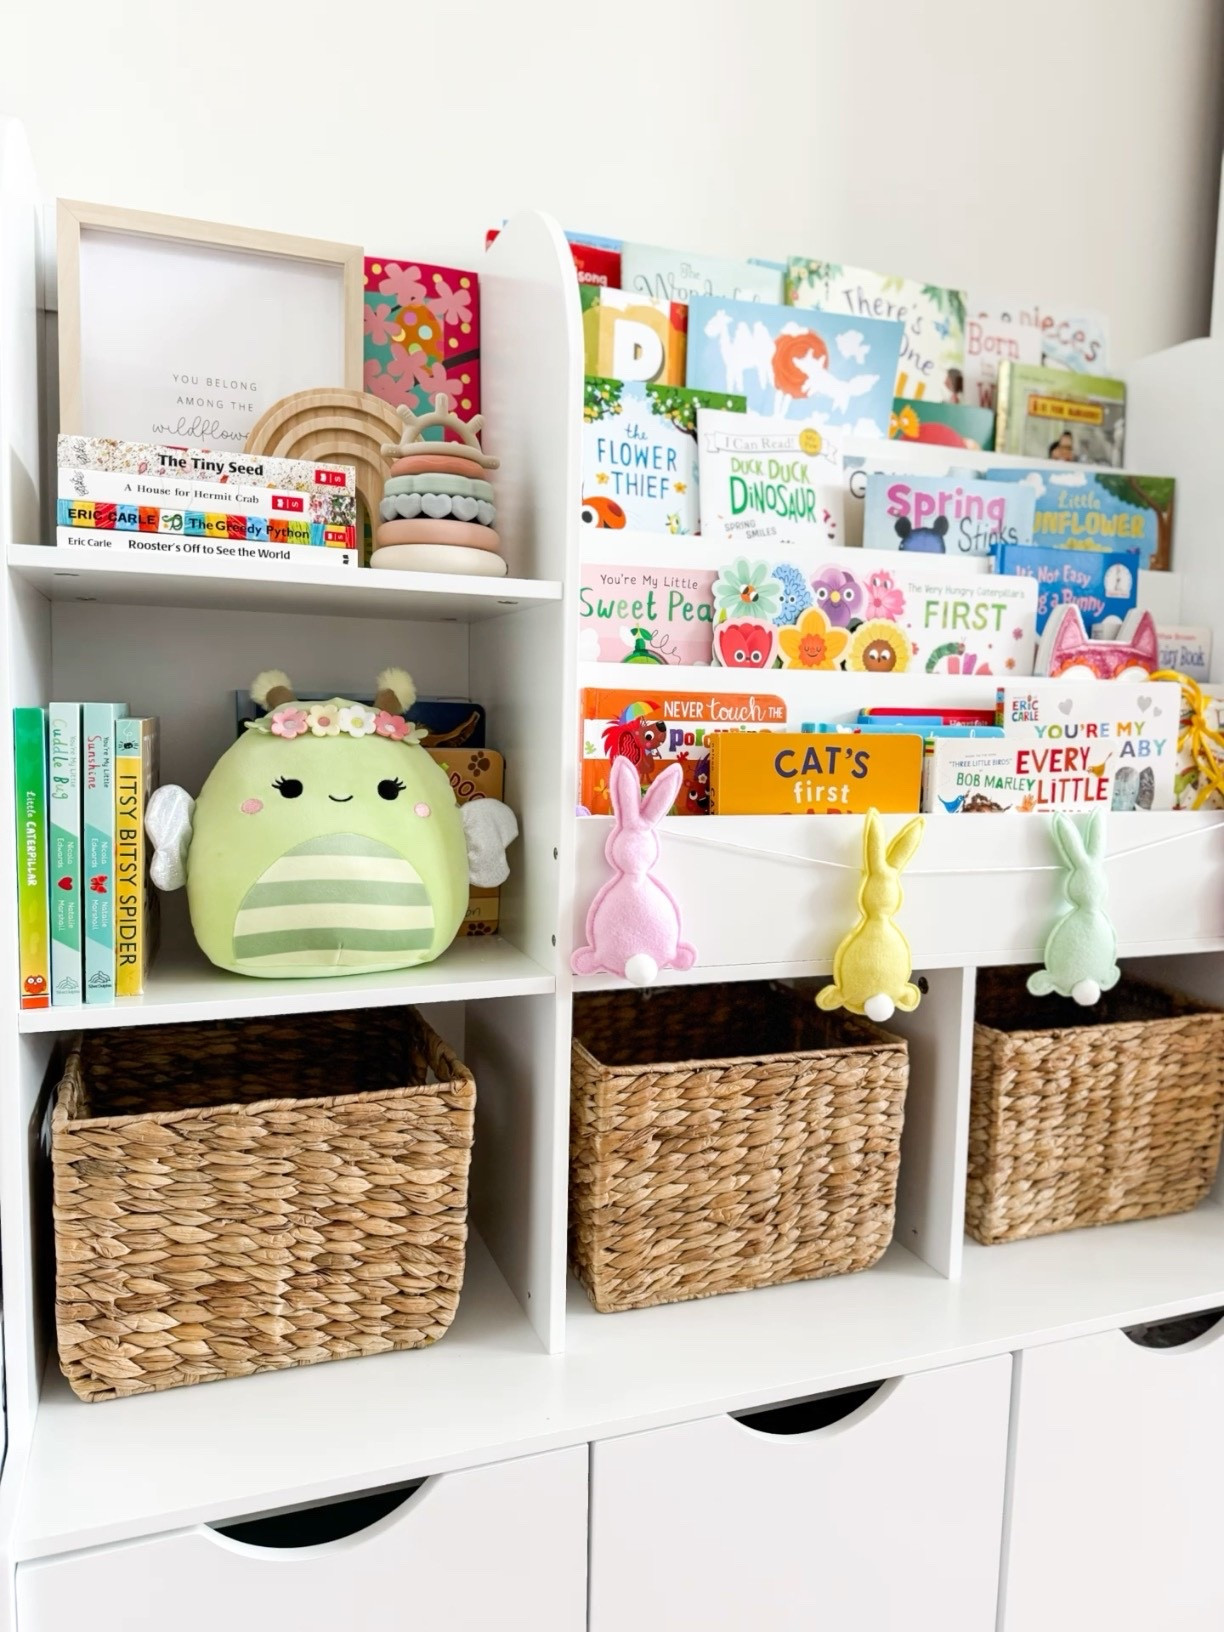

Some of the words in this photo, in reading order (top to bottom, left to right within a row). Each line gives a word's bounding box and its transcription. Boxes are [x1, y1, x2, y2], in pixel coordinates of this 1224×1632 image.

[968, 321, 1019, 360] Born
[172, 374, 199, 385] YOU
[206, 377, 258, 392] BELONG
[176, 396, 224, 409] AMONG
[231, 401, 254, 412] THE
[624, 423, 648, 441] the
[597, 437, 677, 472] FLOWER
[733, 438, 758, 450] Can
[158, 453, 187, 469] The
[191, 457, 225, 475] Tiny
[228, 461, 264, 476] Seed
[730, 457, 763, 476] DUCK
[768, 459, 811, 484] DUCK
[124, 483, 132, 492] A
[137, 484, 171, 496] House
[175, 487, 191, 497] for
[194, 490, 231, 502] Hermit
[235, 493, 259, 504] Crab
[611, 471, 670, 500] THIEF
[67, 508, 103, 520] ERIC
[107, 512, 156, 525] CARLE
[887, 483, 1006, 535] Spring
[189, 518, 213, 529] The
[215, 521, 262, 537] Greedy
[266, 525, 310, 539] Python
[724, 519, 756, 532] SPRING
[746, 526, 777, 540] SMILES
[68, 537, 86, 546] Eric
[87, 538, 112, 548] Carle
[128, 540, 181, 552] Rooster's
[183, 543, 202, 554] Off
[203, 545, 214, 554] to
[216, 546, 236, 556] See
[238, 547, 255, 558] the
[258, 549, 291, 560] World
[600, 574, 636, 586] You're
[642, 575, 658, 589] My
[664, 576, 698, 590] Little
[1038, 566, 1059, 583] Not
[1063, 564, 1091, 588] Easy
[908, 583, 921, 593] The
[925, 584, 942, 597] Very
[945, 586, 974, 597] Hungry
[579, 587, 658, 621] Sweet
[668, 591, 713, 623] Pea
[924, 600, 1008, 632] FIRST
[663, 700, 704, 718] NEVER
[706, 696, 766, 721] touch
[768, 706, 784, 719] THE
[1011, 711, 1039, 722] CARLE
[1034, 722, 1110, 739] YOU'RE
[1117, 721, 1146, 737] MY
[52, 718, 69, 768] Cuddle
[1119, 738, 1167, 758] ABY
[87, 735, 102, 789] Sunshine
[102, 758, 110, 767] My
[774, 746, 871, 779] CAT'S
[1016, 746, 1091, 775] EVERY
[52, 776, 69, 799] Bug
[793, 780, 850, 804] first
[956, 772, 980, 787] BOB
[984, 774, 1037, 791] MARLEY
[119, 775, 137, 820] ITSY
[119, 829, 137, 887] BITSY
[119, 895, 137, 967] SPIDER
